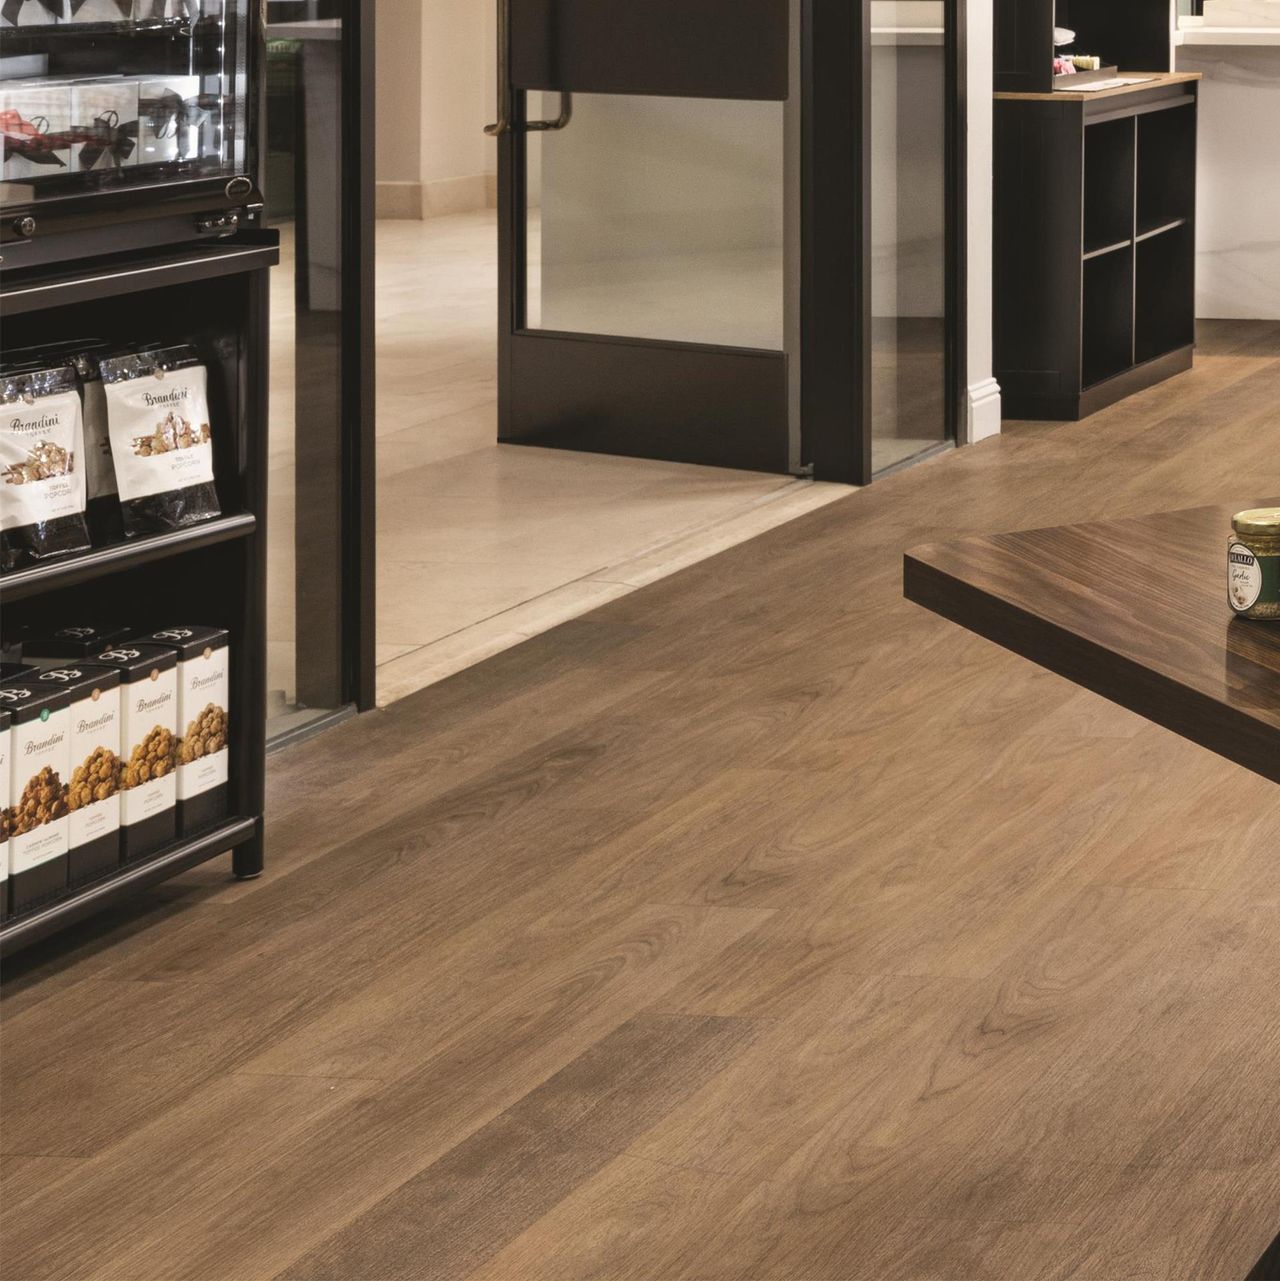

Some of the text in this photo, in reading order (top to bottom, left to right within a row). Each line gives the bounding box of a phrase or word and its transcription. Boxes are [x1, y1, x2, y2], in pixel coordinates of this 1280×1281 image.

[191, 668, 224, 689] Brandini
[137, 690, 172, 713] Brandini
[77, 710, 114, 734] Brandini
[24, 731, 64, 755] Brandini
